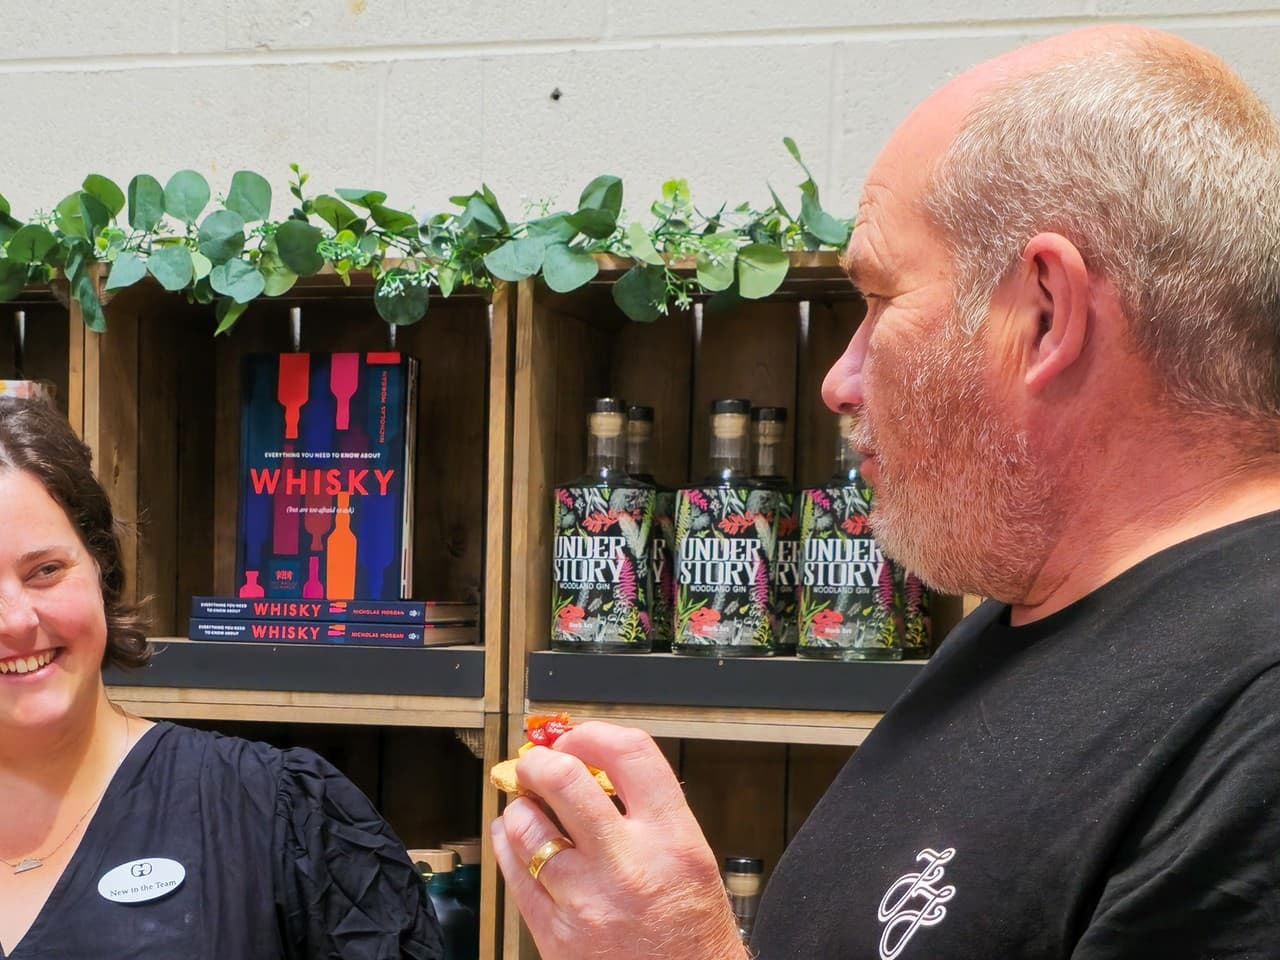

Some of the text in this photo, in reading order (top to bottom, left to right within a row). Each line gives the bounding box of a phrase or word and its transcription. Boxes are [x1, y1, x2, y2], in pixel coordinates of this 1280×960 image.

[250, 468, 394, 495] WHISKY
[556, 536, 626, 559] UNDER
[681, 538, 761, 561] UNDER
[554, 558, 625, 583] STORY
[680, 561, 758, 585] STORY
[804, 562, 885, 586] STORY
[559, 582, 610, 590] WOODLAND GIN
[690, 585, 747, 593] WOODLAND GIN
[813, 586, 870, 594] WOODLAND GIN
[254, 603, 321, 617] WHISKY
[252, 625, 320, 640] WHISKY
[110, 887, 129, 896] New
[141, 883, 153, 891] the
[156, 880, 177, 888] Team
